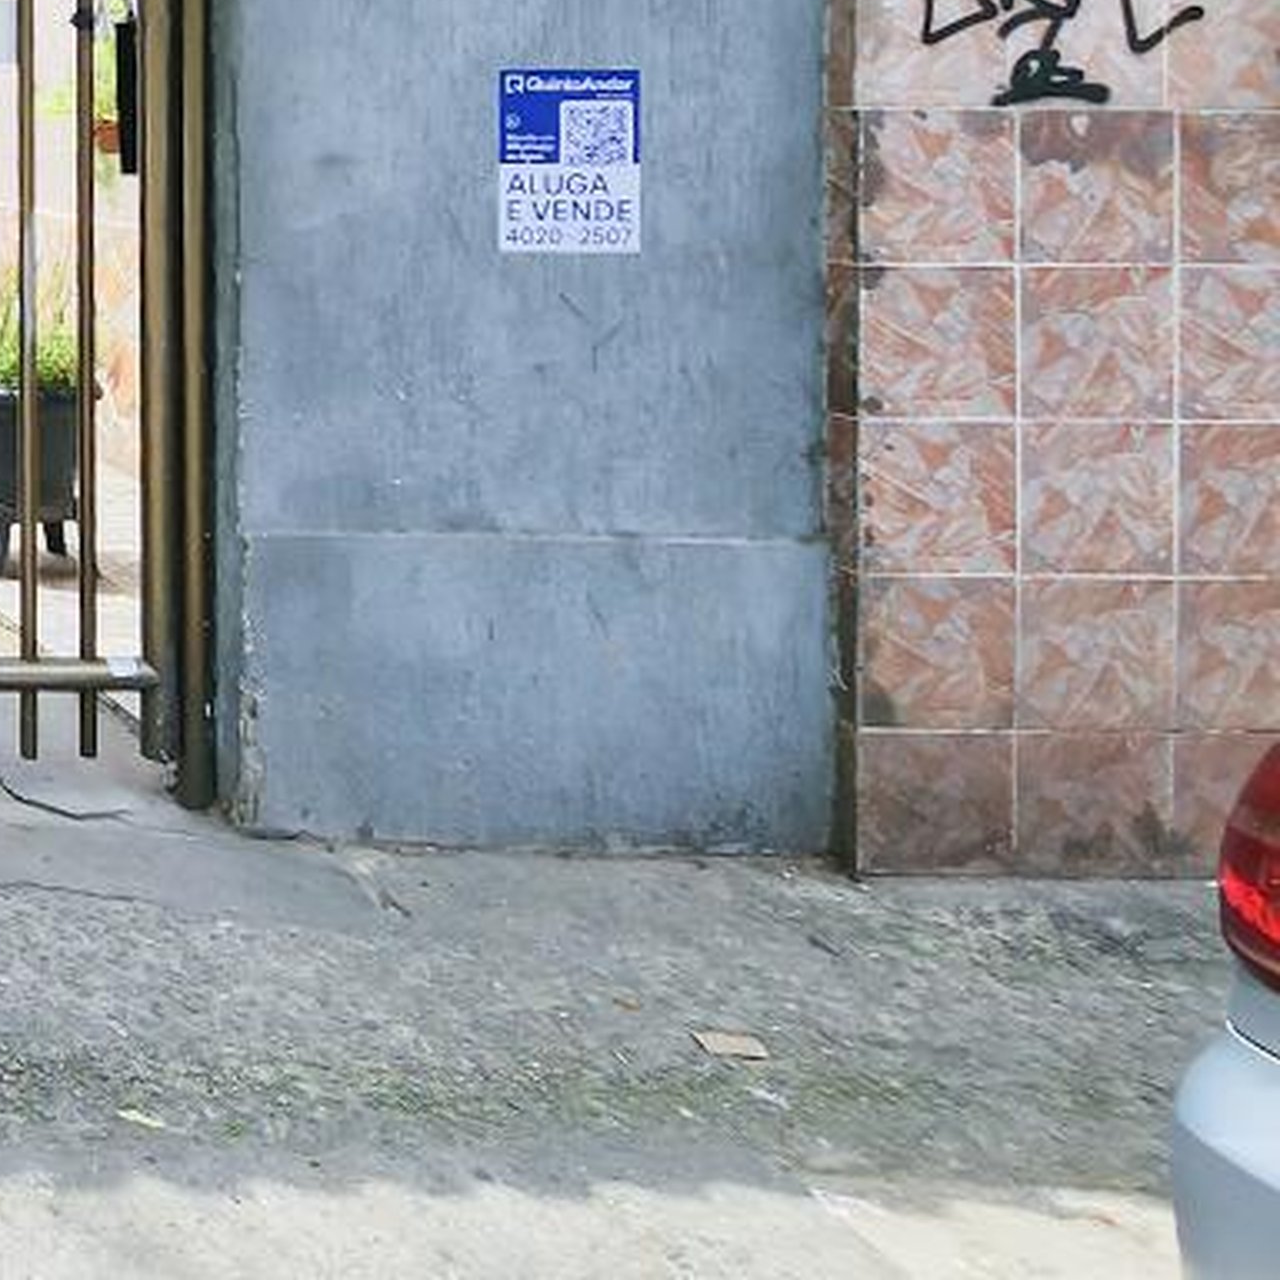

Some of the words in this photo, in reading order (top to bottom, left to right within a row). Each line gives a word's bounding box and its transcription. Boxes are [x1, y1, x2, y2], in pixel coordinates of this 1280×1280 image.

[506, 172, 610, 195] ALUGA
[506, 199, 522, 221] E
[532, 199, 633, 221] VENDE
